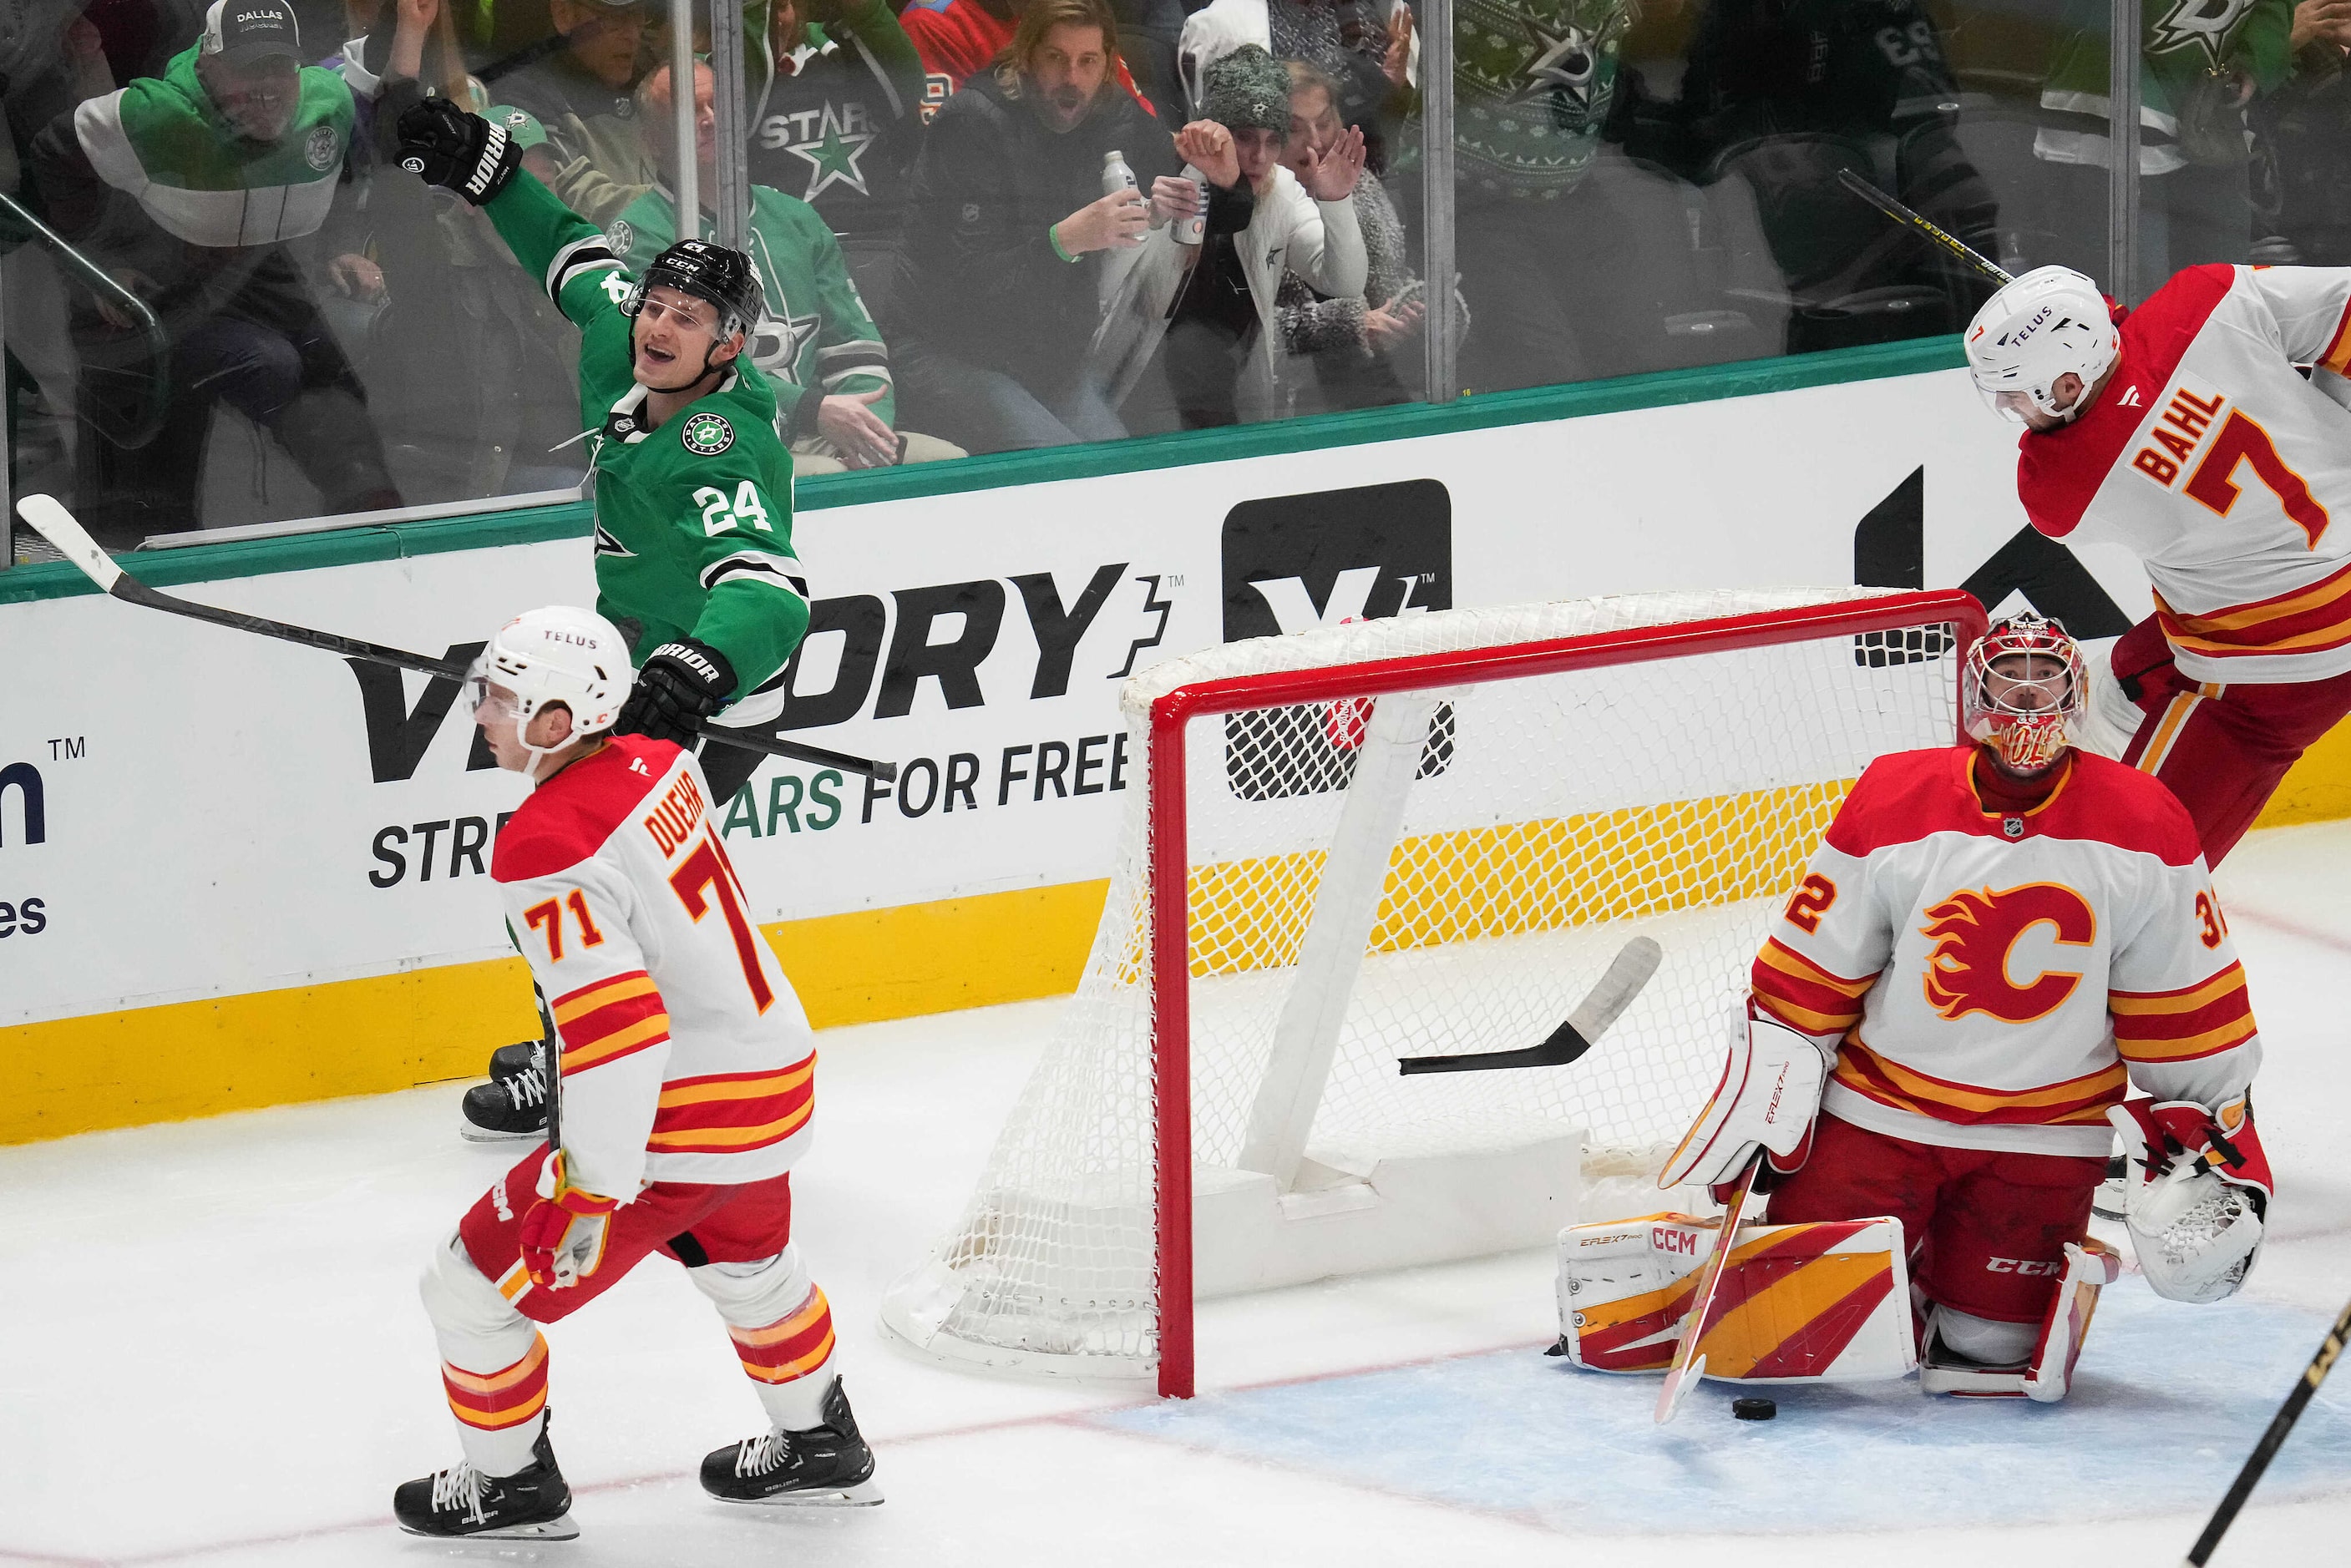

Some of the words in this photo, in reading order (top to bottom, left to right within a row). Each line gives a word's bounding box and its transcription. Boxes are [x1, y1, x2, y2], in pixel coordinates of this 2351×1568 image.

[237, 10, 283, 23] DALLAS
[465, 119, 508, 195] RRIOR
[666, 257, 700, 272] CCM
[1971, 326, 1985, 343] 7
[2011, 306, 2054, 348] TELUS
[685, 415, 730, 437] DALLAS
[2131, 387, 2226, 488] BAHL
[689, 436, 731, 453] STARS
[2181, 406, 2330, 553] 7
[692, 479, 773, 537] 24
[544, 630, 597, 650] TELUS
[641, 642, 721, 684] RRIOR
[368, 810, 519, 889] STR
[721, 770, 844, 841] ARS
[998, 731, 1128, 807] FREE
[644, 769, 705, 861] DUEHR
[523, 888, 605, 964] 71
[1652, 1227, 1699, 1256] CCM
[764, 1477, 801, 1492] BAUER
[461, 1510, 499, 1525] BAER
